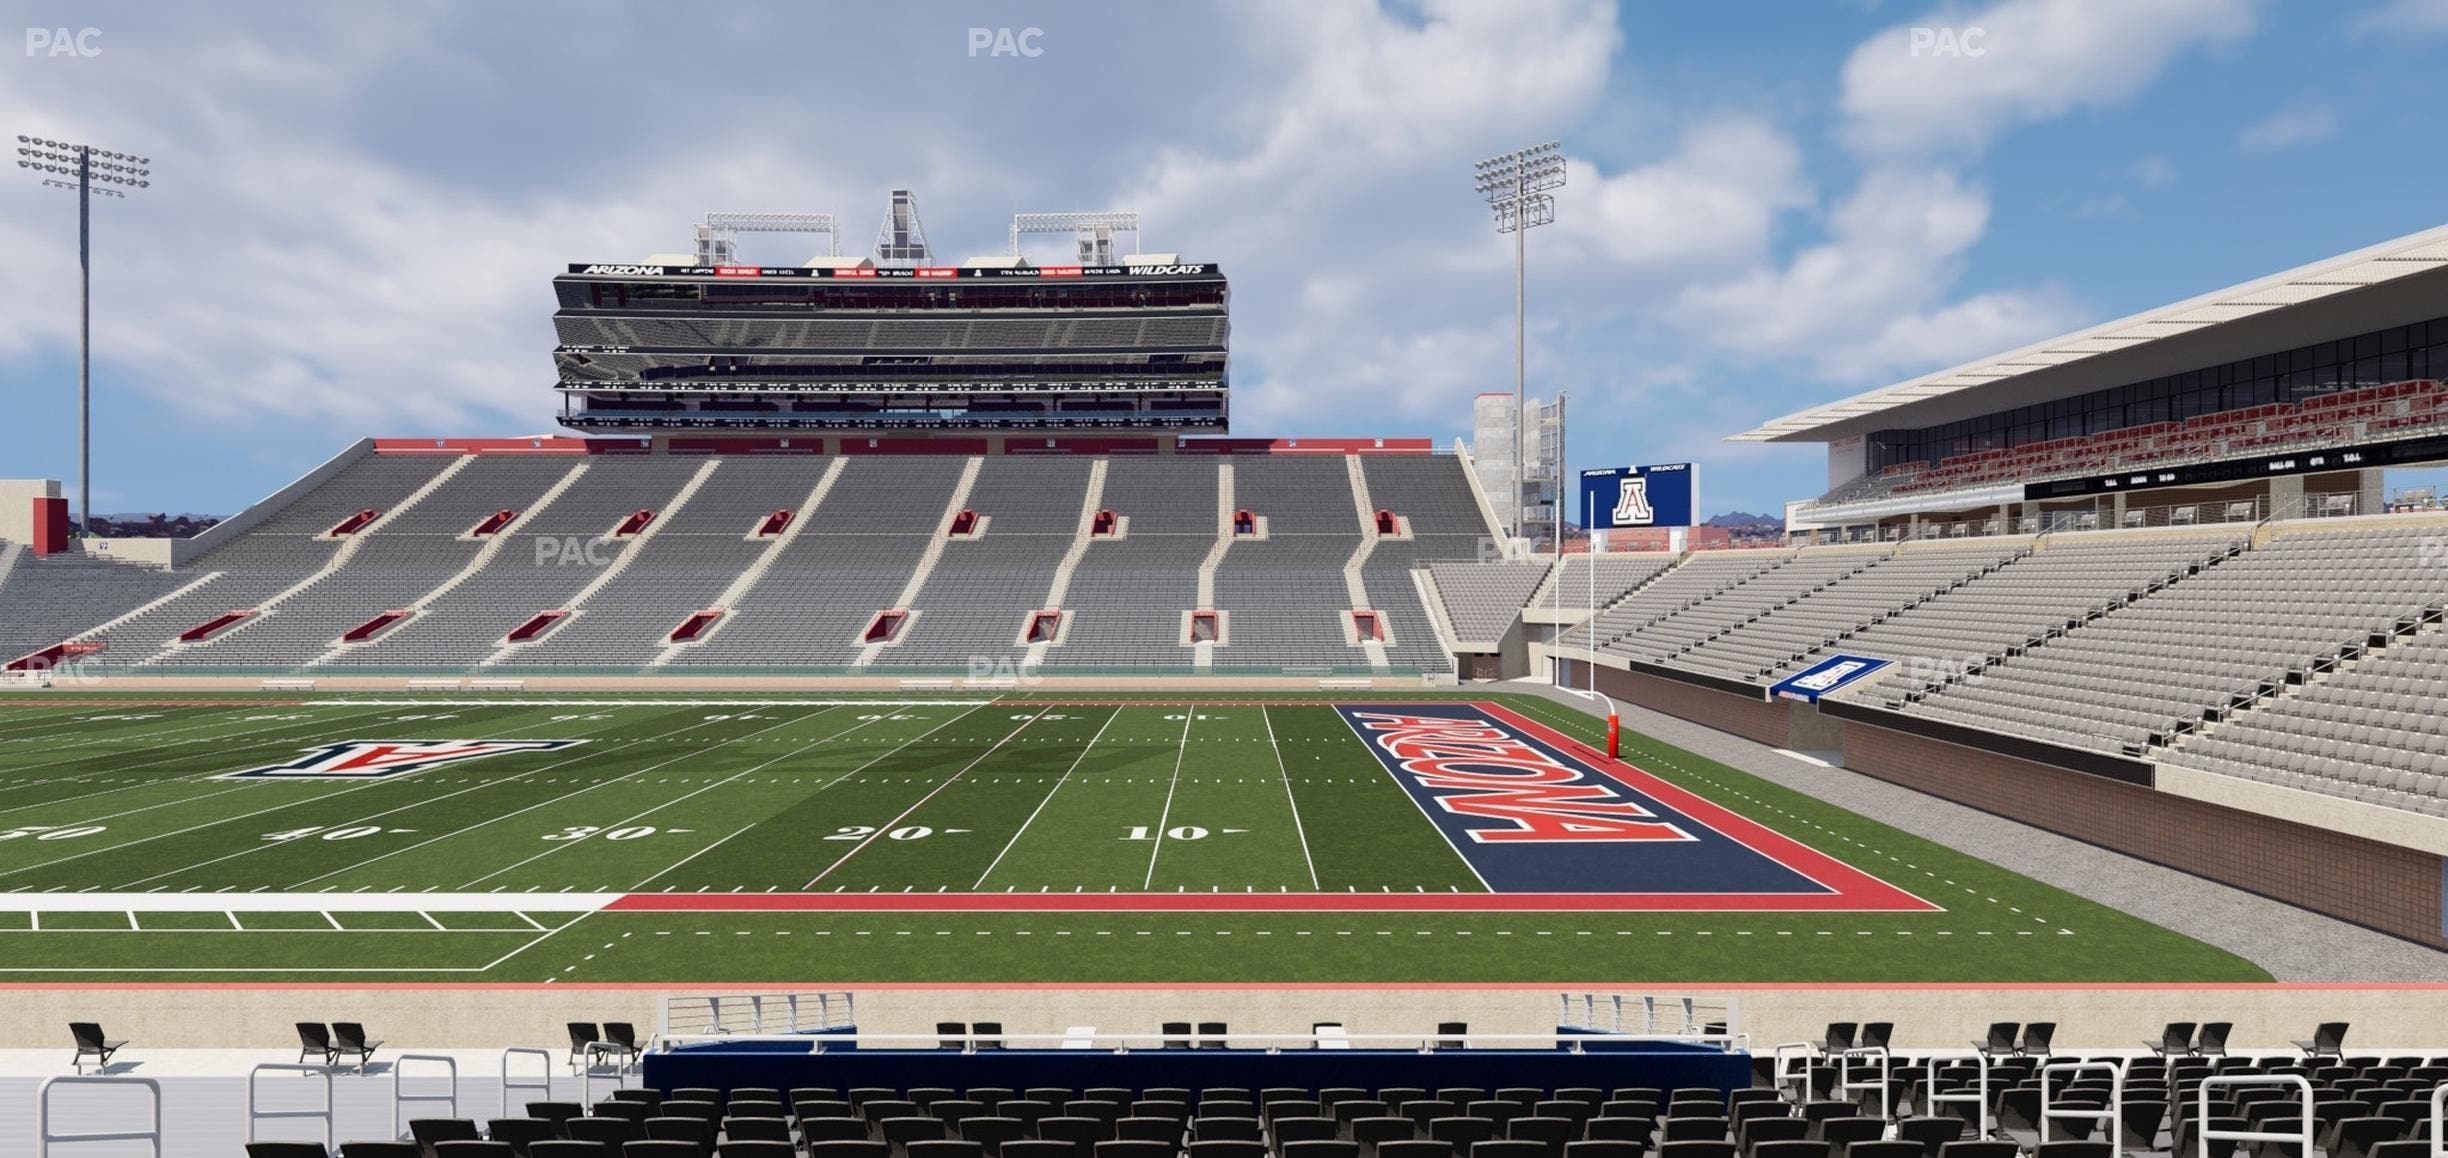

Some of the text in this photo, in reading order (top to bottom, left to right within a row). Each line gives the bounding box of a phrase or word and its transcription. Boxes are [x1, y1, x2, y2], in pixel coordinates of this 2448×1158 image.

[583, 265, 664, 275] ARIZONA
[1129, 265, 1204, 275] WILDCATS
[1612, 478, 1653, 525] A
[204, 739, 593, 780] A
[1352, 712, 1701, 843] ARIZONA
[260, 826, 382, 840] 40
[541, 826, 656, 840] 30
[823, 825, 933, 840] 20
[1118, 825, 1209, 840] 10
